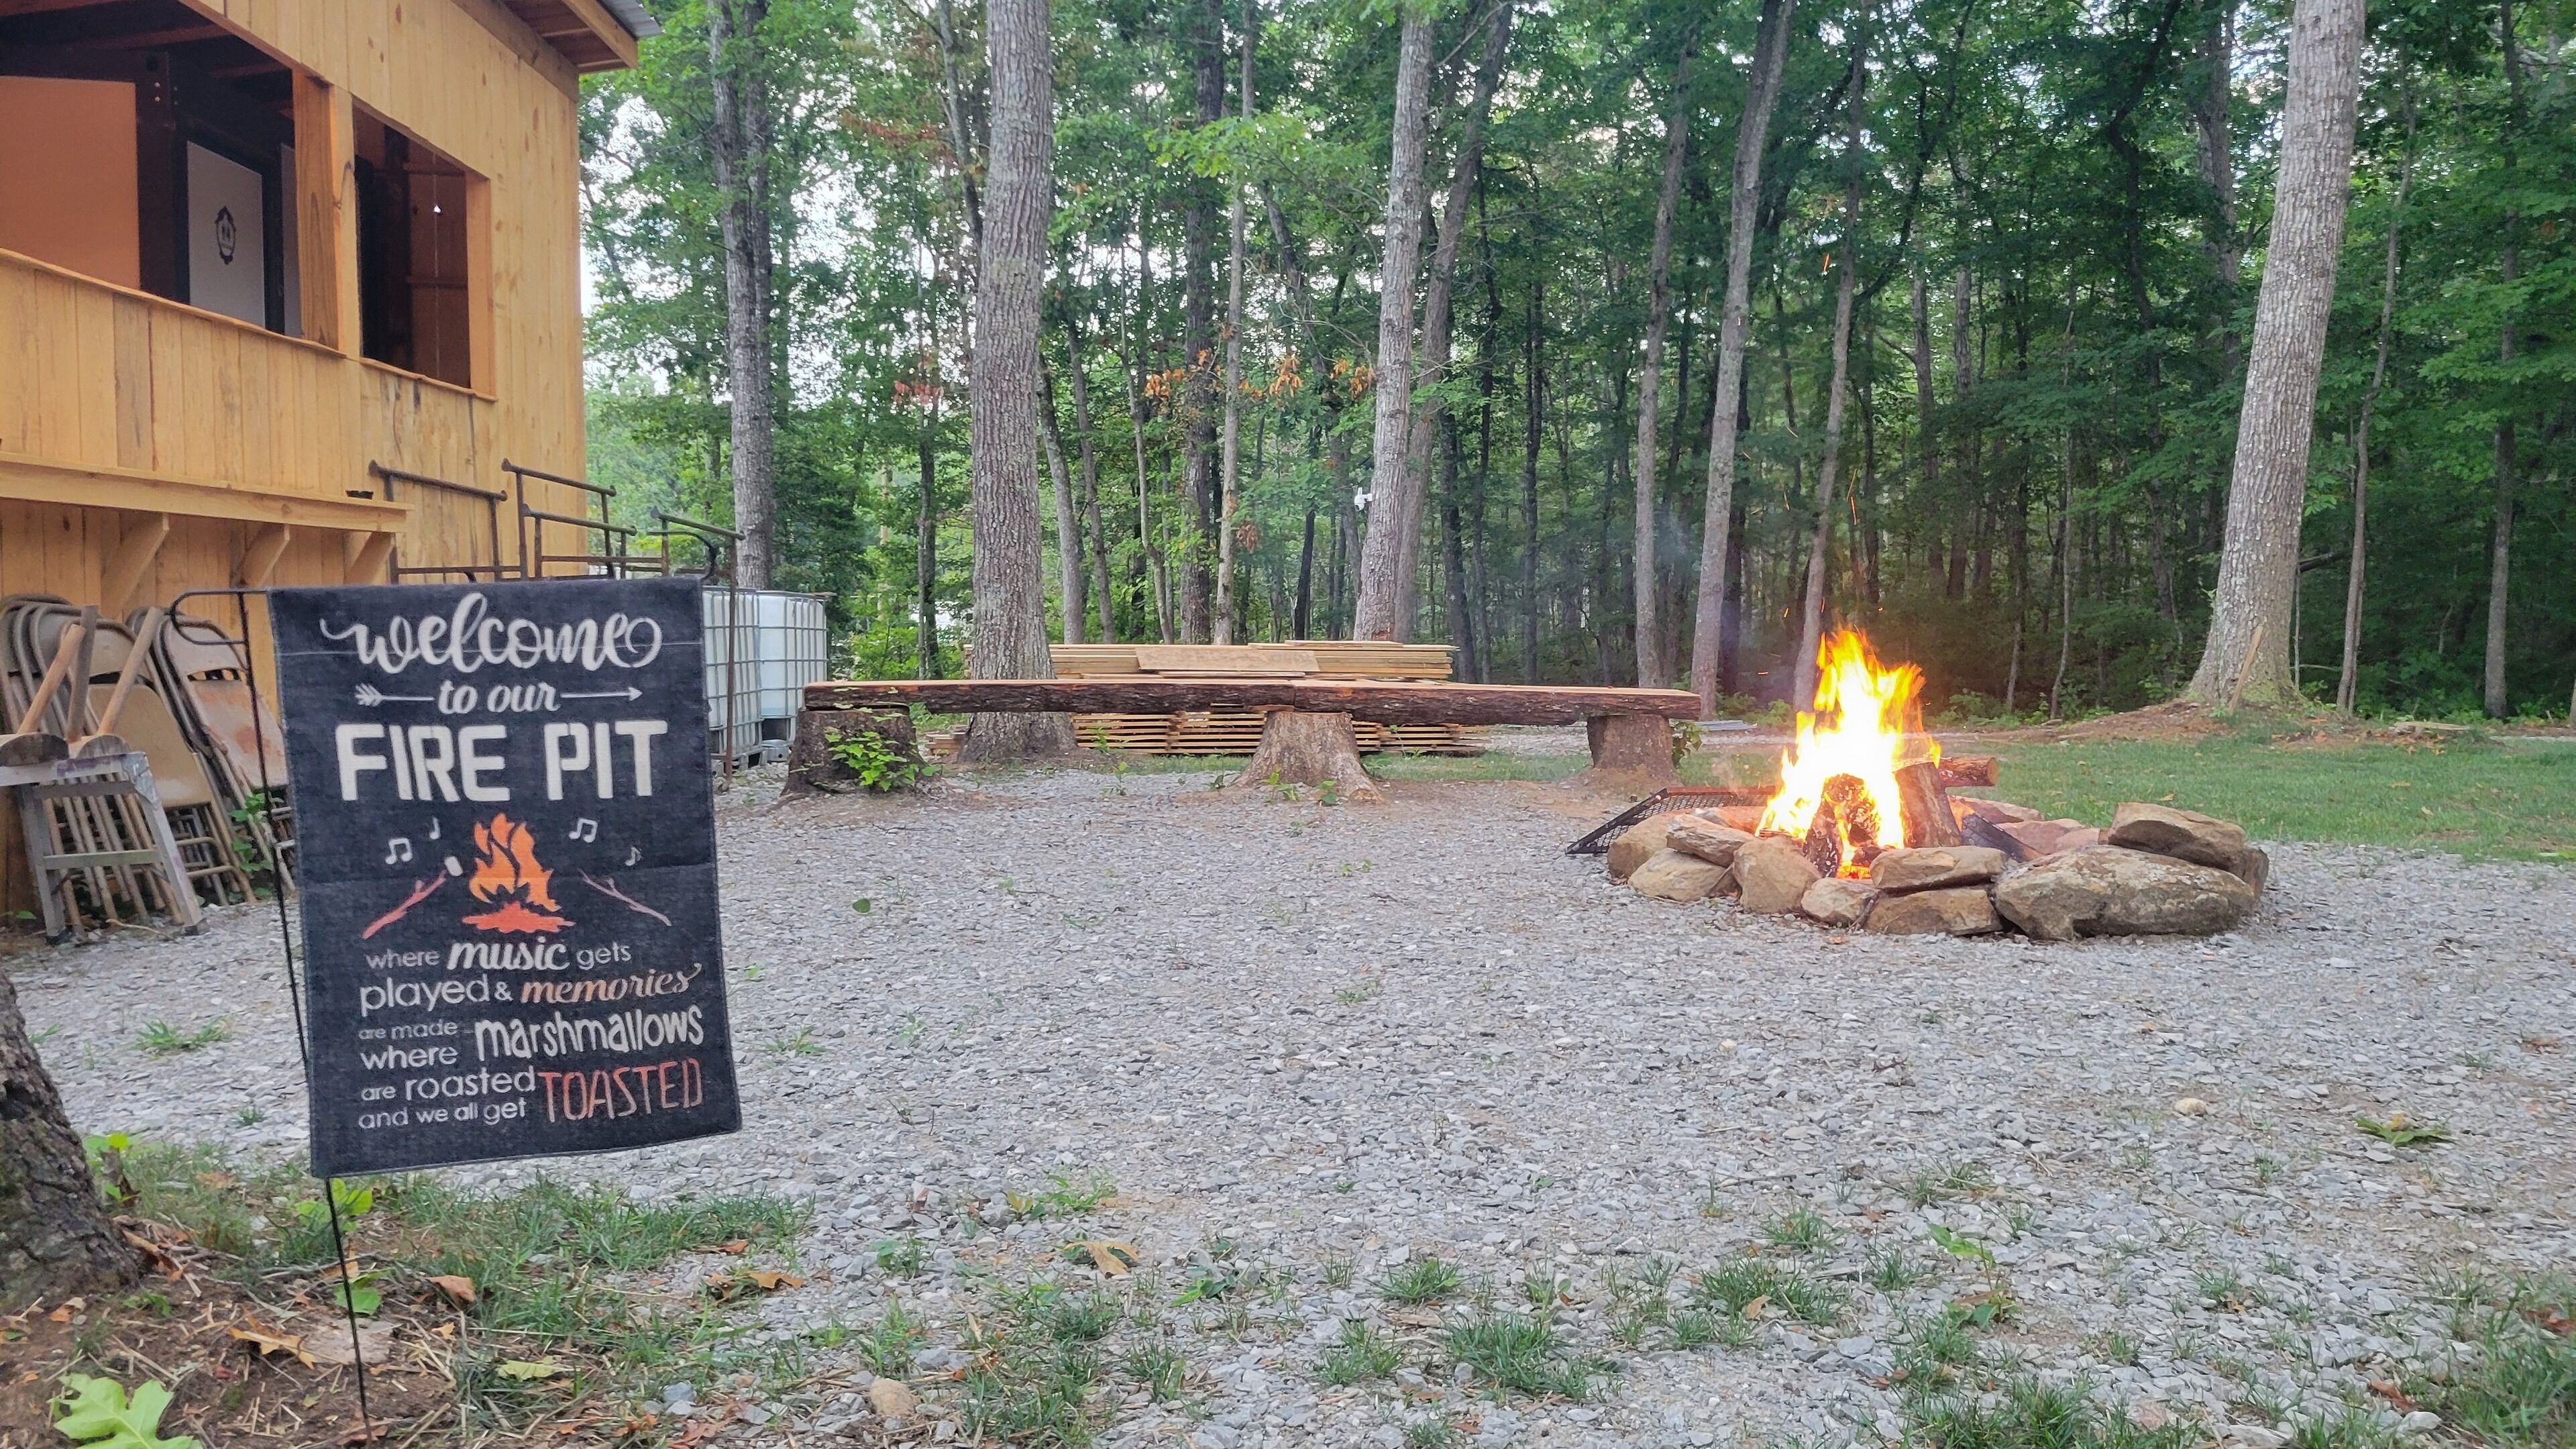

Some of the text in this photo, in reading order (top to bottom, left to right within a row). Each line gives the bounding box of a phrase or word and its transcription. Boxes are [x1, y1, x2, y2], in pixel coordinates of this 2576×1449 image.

[320, 592, 662, 674] welcome
[438, 679, 561, 714] to our
[335, 720, 668, 802] FIRE PIT
[366, 936, 632, 970] where music gets
[359, 963, 702, 1017] played & memories
[358, 1019, 458, 1040] are made
[360, 1004, 704, 1069] where marshmallows
[358, 1057, 703, 1128] and we all get TOASTED
[361, 1065, 536, 1101] are roasted
